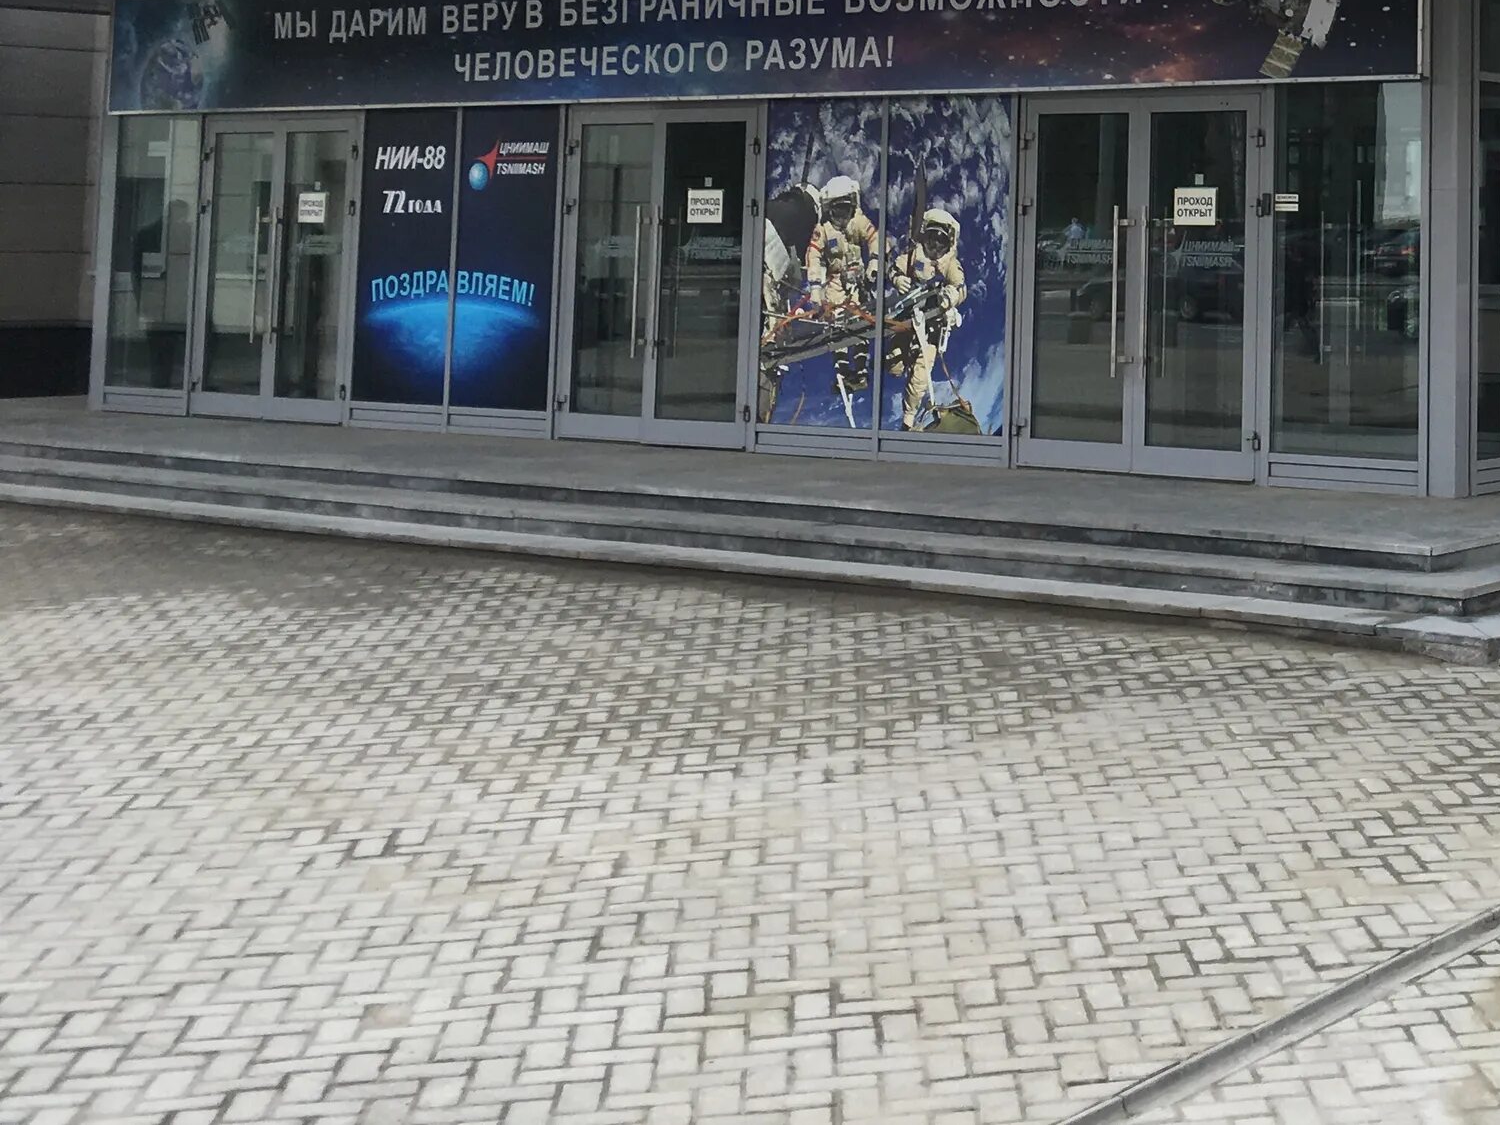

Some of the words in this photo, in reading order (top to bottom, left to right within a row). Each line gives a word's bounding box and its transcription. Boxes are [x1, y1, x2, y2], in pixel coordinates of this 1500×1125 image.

[274, 10, 316, 39] МЫ
[329, 6, 427, 43] ДАРИМ
[442, 1, 518, 34] ВЕРУ
[525, 0, 543, 28] В
[454, 41, 728, 82] ЧЕЛОВЕЧЕСКОГО
[746, 36, 894, 71] РАЗУМА!
[499, 141, 550, 156] ЦНИИМАШ
[375, 145, 447, 170] НИИ-88
[496, 163, 545, 175] TSNIIMASH
[383, 190, 406, 214] 72
[690, 197, 720, 207] ПРОХОД
[1177, 196, 1213, 207] ПРОХОД
[689, 207, 720, 216] ОТКРЫТ
[1177, 208, 1212, 218] ОТКРЫТ
